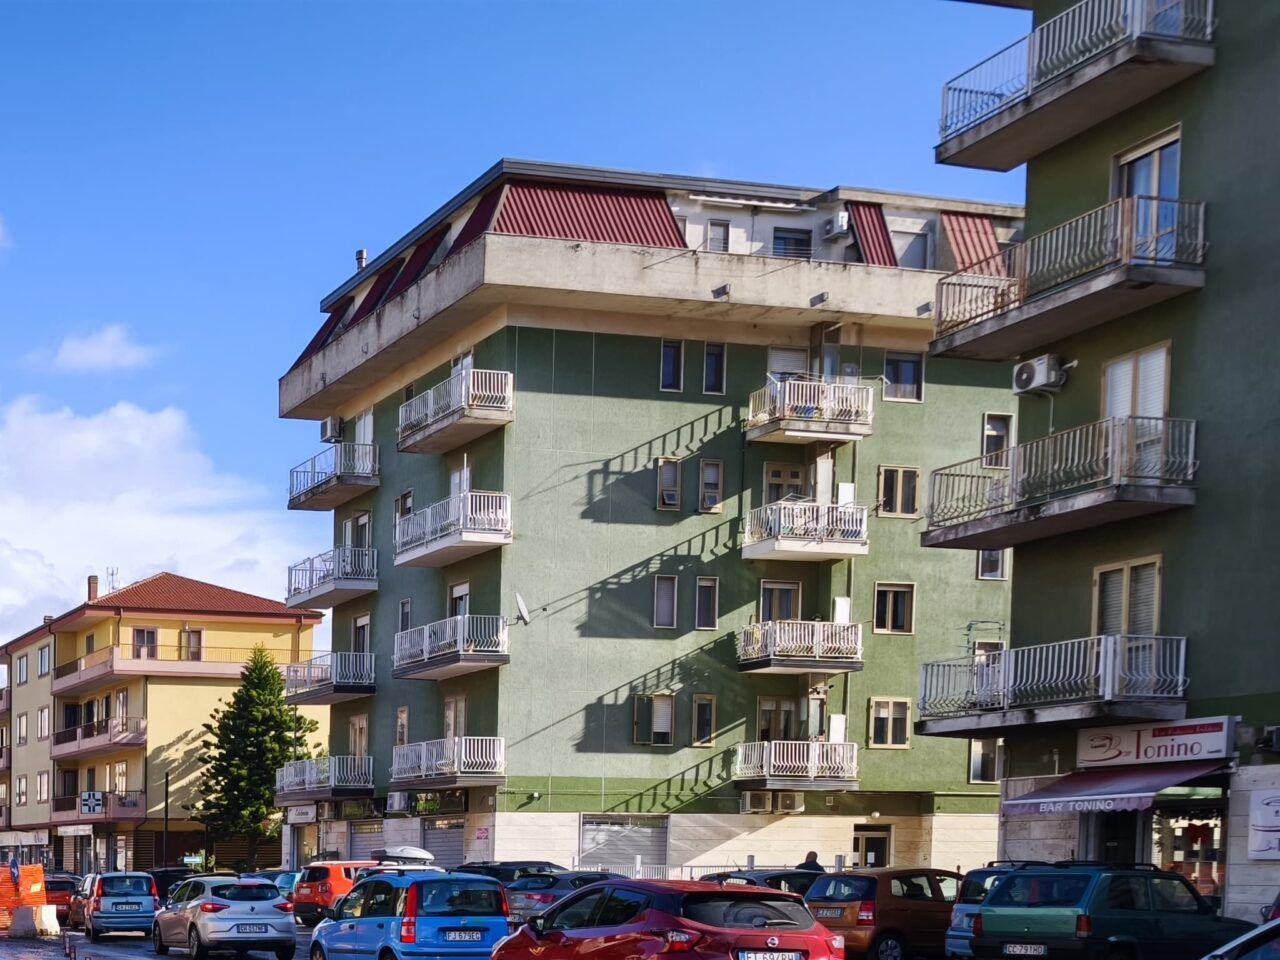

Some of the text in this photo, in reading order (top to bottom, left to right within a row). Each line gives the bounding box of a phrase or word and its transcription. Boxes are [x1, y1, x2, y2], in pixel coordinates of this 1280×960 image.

[1130, 729, 1203, 760] Tonino
[1039, 800, 1114, 812] BAR TONINO
